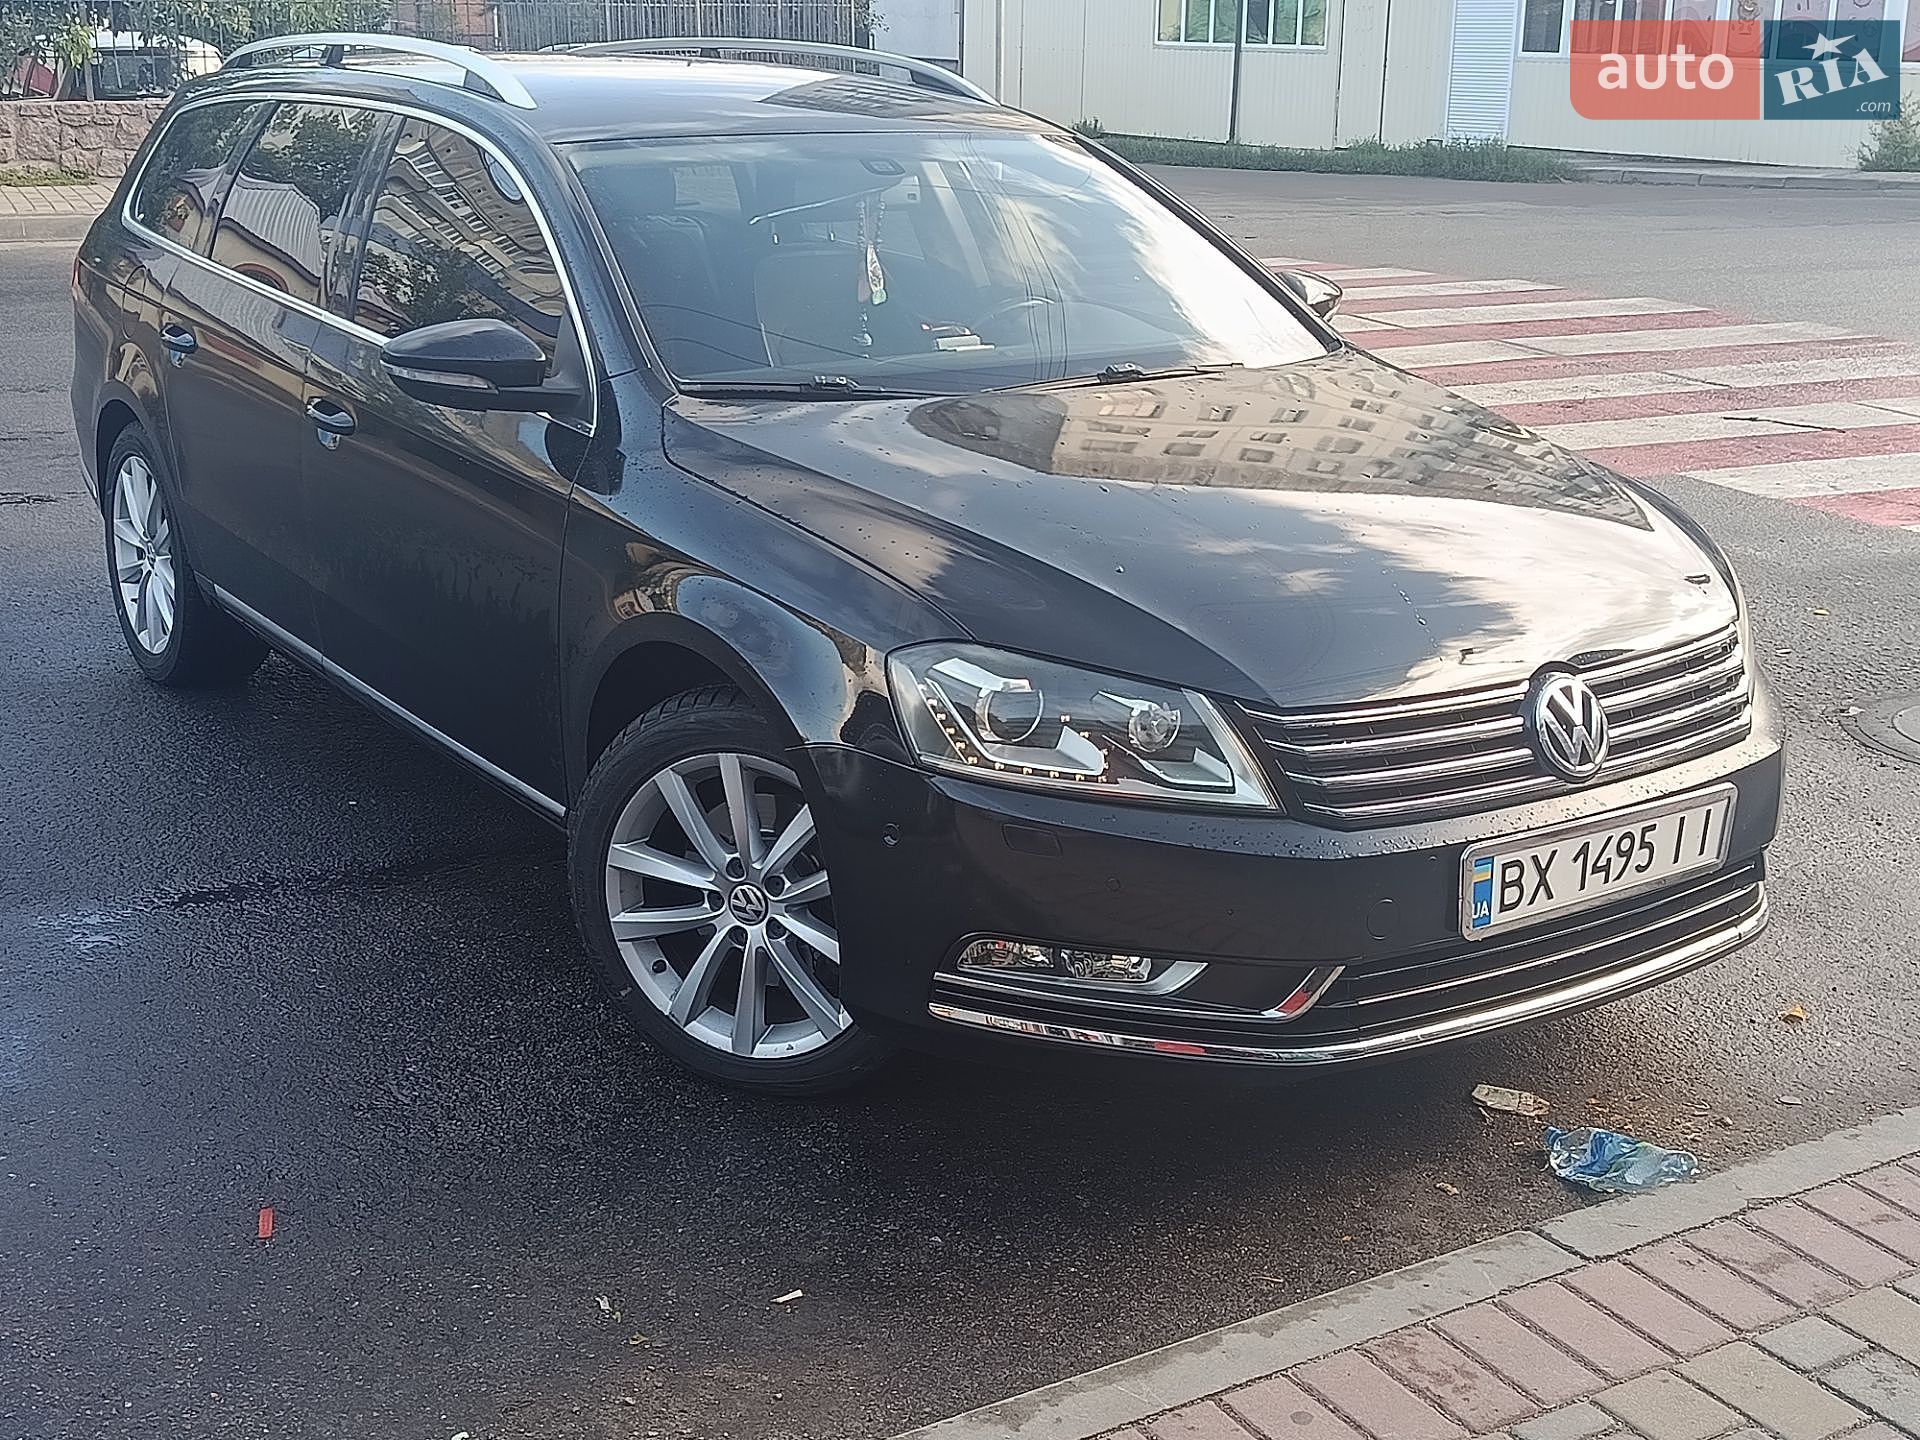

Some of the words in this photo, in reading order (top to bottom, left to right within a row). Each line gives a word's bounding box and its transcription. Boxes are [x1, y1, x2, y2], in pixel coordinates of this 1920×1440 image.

[1498, 849, 1558, 914] BX
[1572, 824, 1657, 891] 1495
[1472, 902, 1489, 918] UA
